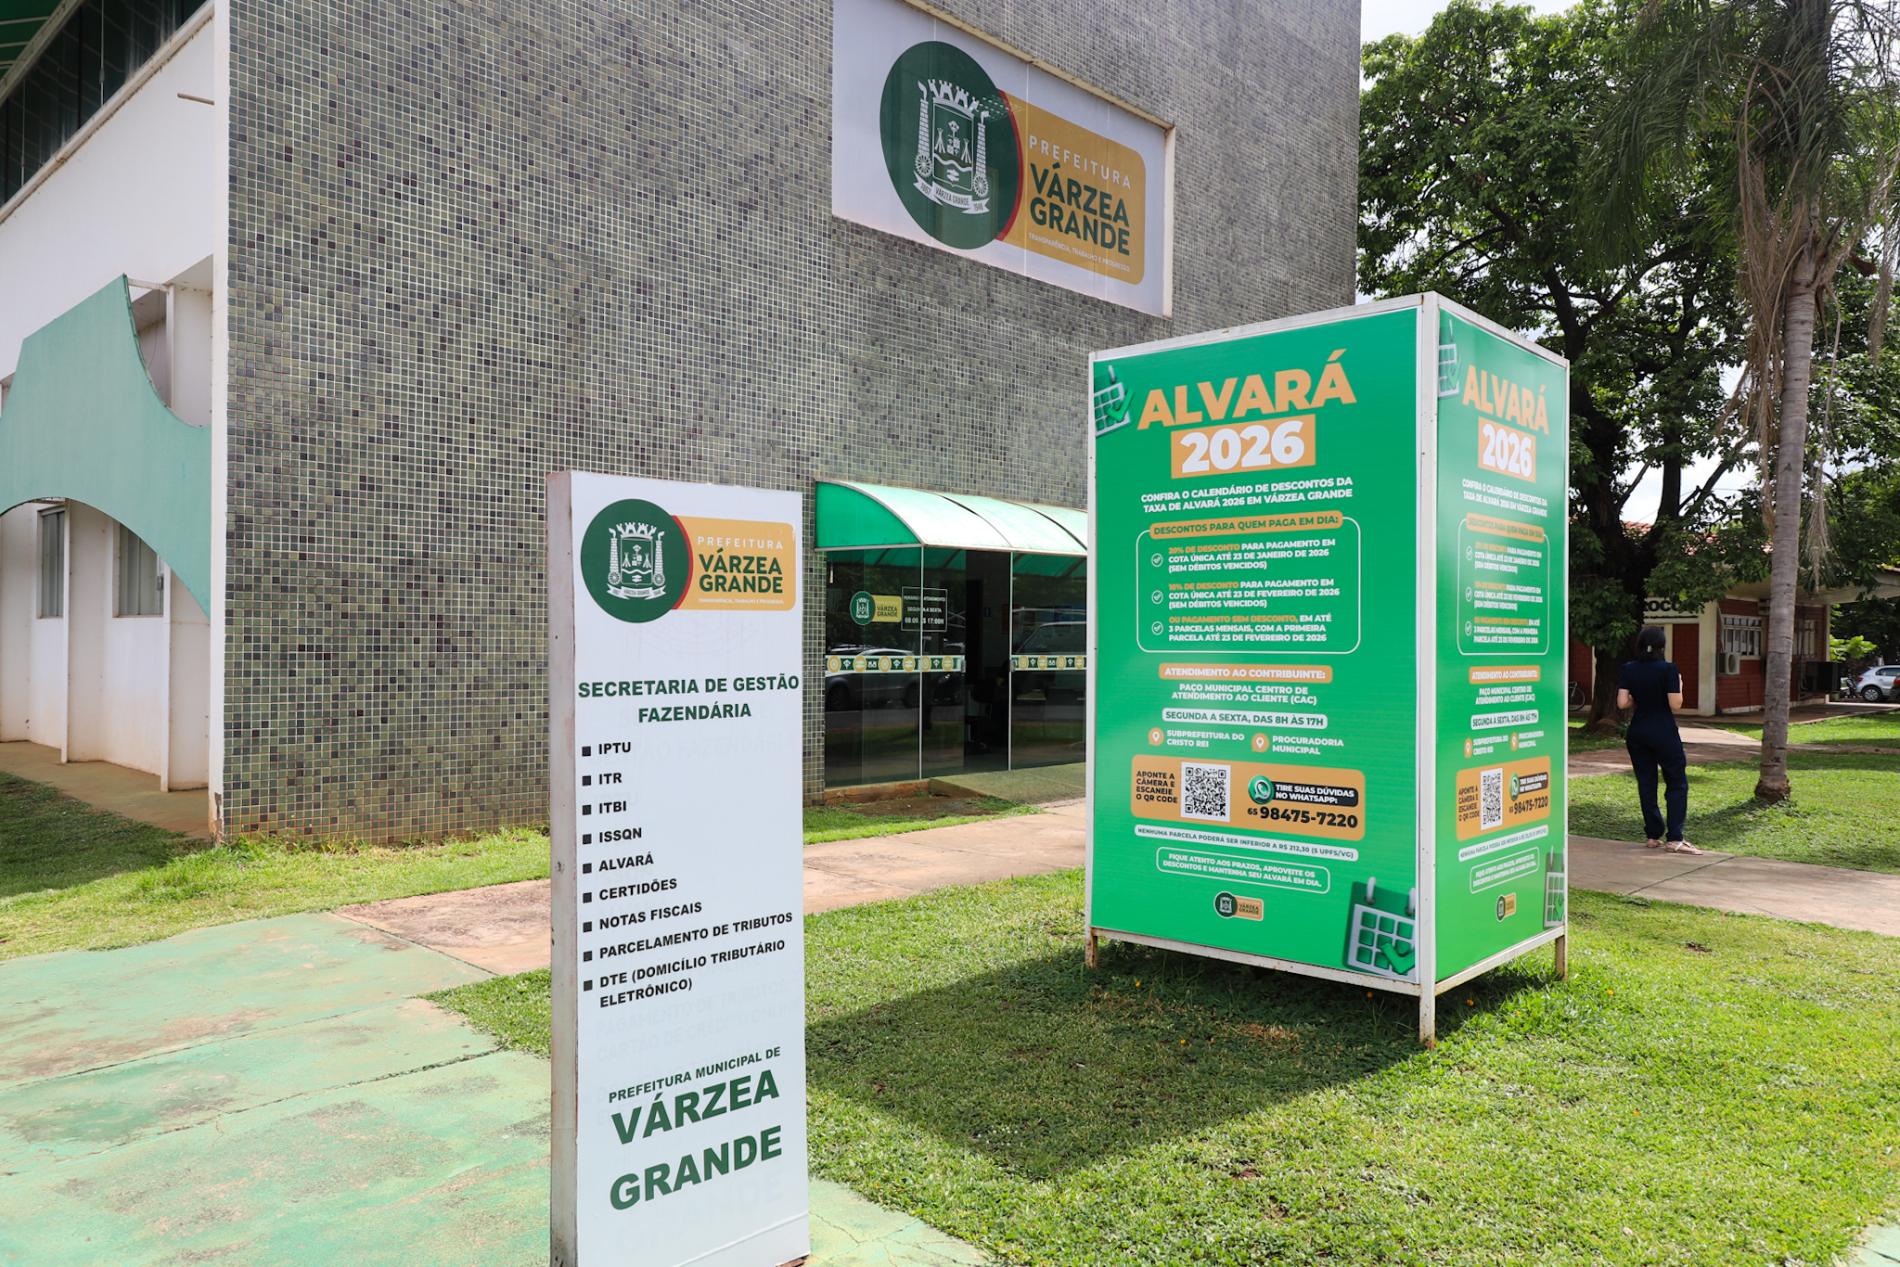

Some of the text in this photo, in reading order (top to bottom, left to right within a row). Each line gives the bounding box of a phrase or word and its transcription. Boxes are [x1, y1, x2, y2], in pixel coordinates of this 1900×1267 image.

[1029, 135, 1132, 190] PREFEITURA
[1030, 162, 1130, 227] VÁRZEA
[1030, 197, 1130, 256] GRANDE
[1137, 348, 1357, 431] ALVARÁ
[1462, 364, 1550, 434] ALVARÁ
[1180, 420, 1304, 473] 2026
[1482, 424, 1532, 477] 2026
[1142, 477, 1352, 503] CONFIRA O CALENDÁRIO DE DESCONTOS DA
[1144, 489, 1352, 512] TAXA DE ALVARÁ 2026 EM VÁRZEA GRANDE
[1154, 516, 1338, 534] DESCONTOS PARA QUEM PAGA EM DIA:
[697, 536, 783, 549] PREFEITURA
[1266, 540, 1321, 549] PAGAMENTO
[699, 548, 782, 574] VÁRZEA
[1190, 553, 1214, 562] ÚNICA
[1216, 552, 1232, 560] ATÉ
[1257, 551, 1294, 559] JANEIRO
[1223, 562, 1267, 570] VENCIDOS)
[699, 575, 783, 593] GRANDE
[1190, 590, 1214, 599] ÚNICA
[1216, 590, 1232, 598] ATÉ
[1205, 633, 1219, 641] ATÉ
[1165, 668, 1229, 676] ATENDIMENTO
[1232, 669, 1246, 677] AO
[578, 673, 799, 698] SECRETARIA DE GESTÃO
[1180, 684, 1202, 692] PAÇO
[1205, 685, 1252, 693] MUNICIPAL
[1255, 686, 1292, 694] CENTRO
[1172, 692, 1317, 705] ATENDIMENTO AO CLIENTE (CAC)
[638, 701, 751, 723] FAZENDÁRIA
[1166, 712, 1206, 721] SEGUNDA
[1219, 714, 1249, 724] SEXTA,
[1253, 715, 1272, 723] DAS
[1275, 716, 1287, 724] 8H
[1291, 715, 1303, 725] ÀS
[1307, 717, 1323, 726] 17H
[1167, 731, 1229, 740] SUBPREFEITURA
[1273, 736, 1343, 746] PROCURADORIA
[599, 742, 631, 755] IPTU
[1273, 745, 1320, 754] MUNICIPAL
[599, 773, 622, 785] ITR
[1137, 771, 1166, 779] APONTE
[1137, 777, 1167, 787] CÂMERA
[1137, 787, 1172, 795] ESCANEIE
[1276, 784, 1354, 797] TIRE SUAS DÚVIDAS
[1276, 792, 1287, 800] NO
[599, 801, 627, 814] ITBI
[1514, 796, 1548, 814] 98475-7220
[1248, 806, 1358, 828] 65 98475-7220
[599, 827, 642, 843] ISSQN
[1198, 834, 1223, 843] PODERÁ
[599, 852, 654, 872] ALVARÁ
[599, 878, 677, 900] CERTIDÕES
[600, 902, 702, 930] NOTAS FISCAIS
[600, 912, 793, 958] PARCELAMENTO DE TRIBUTOS
[600, 940, 785, 987] DTE (DOMICÍLIO TRIBUTÁRIO
[600, 978, 692, 1008] ELETRÔNICO)
[609, 1047, 780, 1103] PREFEITURA MUNICIPAL DE
[611, 1070, 779, 1145] VÁRZEA
[610, 1125, 782, 1210] GRANDE
